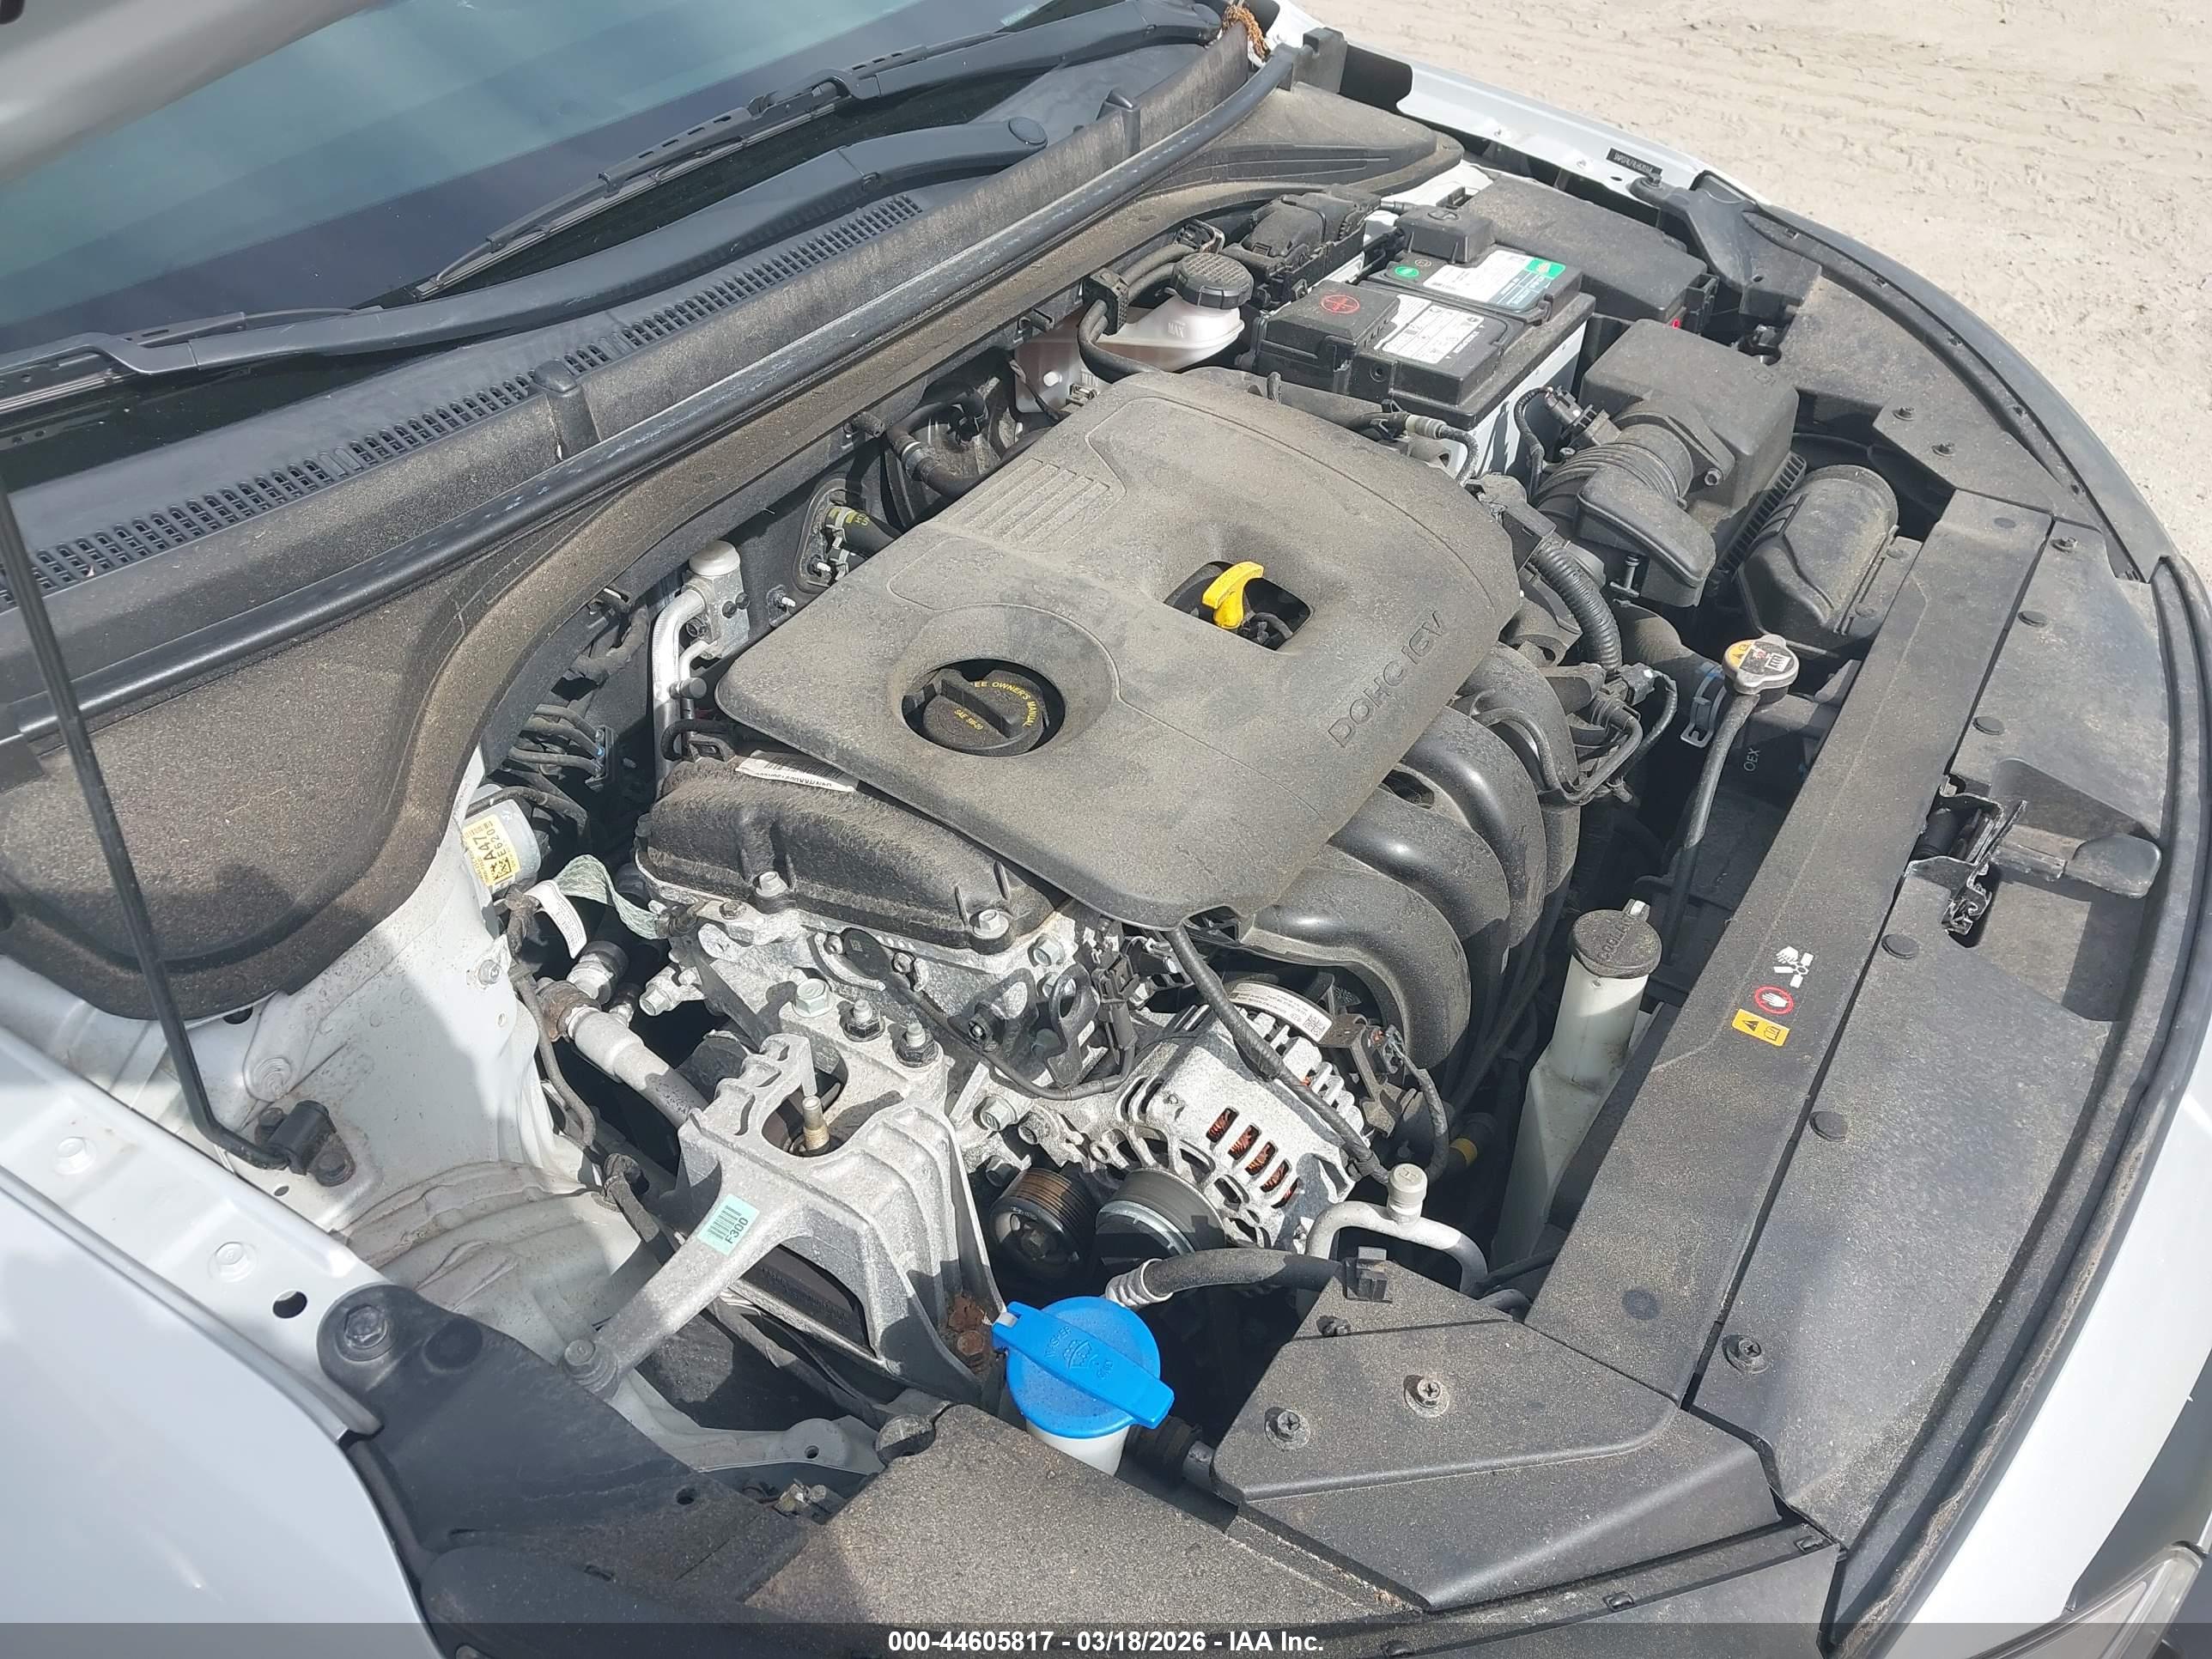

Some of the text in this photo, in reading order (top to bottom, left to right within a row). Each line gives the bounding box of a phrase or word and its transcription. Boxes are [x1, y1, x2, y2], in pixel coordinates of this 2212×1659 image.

[1328, 610, 1443, 749] DOHC 16V
[953, 708, 969, 720] SAE
[992, 681, 1031, 701] OWNER'S
[1023, 701, 1038, 727] MANUAL
[1743, 747, 1760, 772] OEX
[470, 836, 497, 860] A47
[486, 829, 507, 858] E620
[724, 1217, 749, 1244] F300
